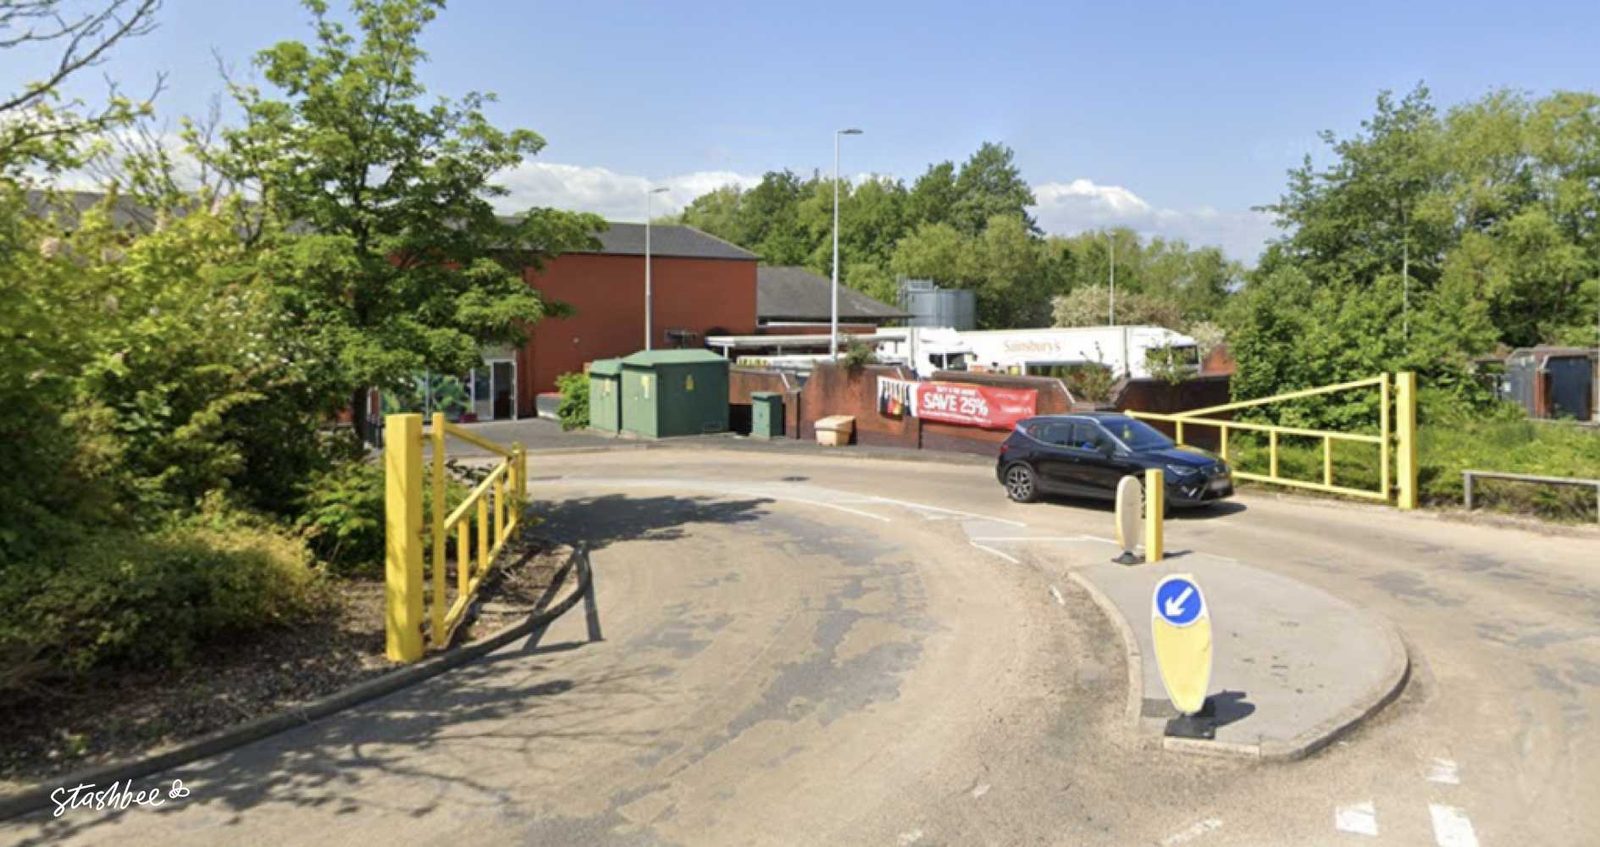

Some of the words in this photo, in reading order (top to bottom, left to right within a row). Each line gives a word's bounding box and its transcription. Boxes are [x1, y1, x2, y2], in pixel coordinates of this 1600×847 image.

[1003, 339, 1061, 353] Sainsbury's
[924, 392, 957, 412] SAVE
[960, 397, 989, 416] 25%
